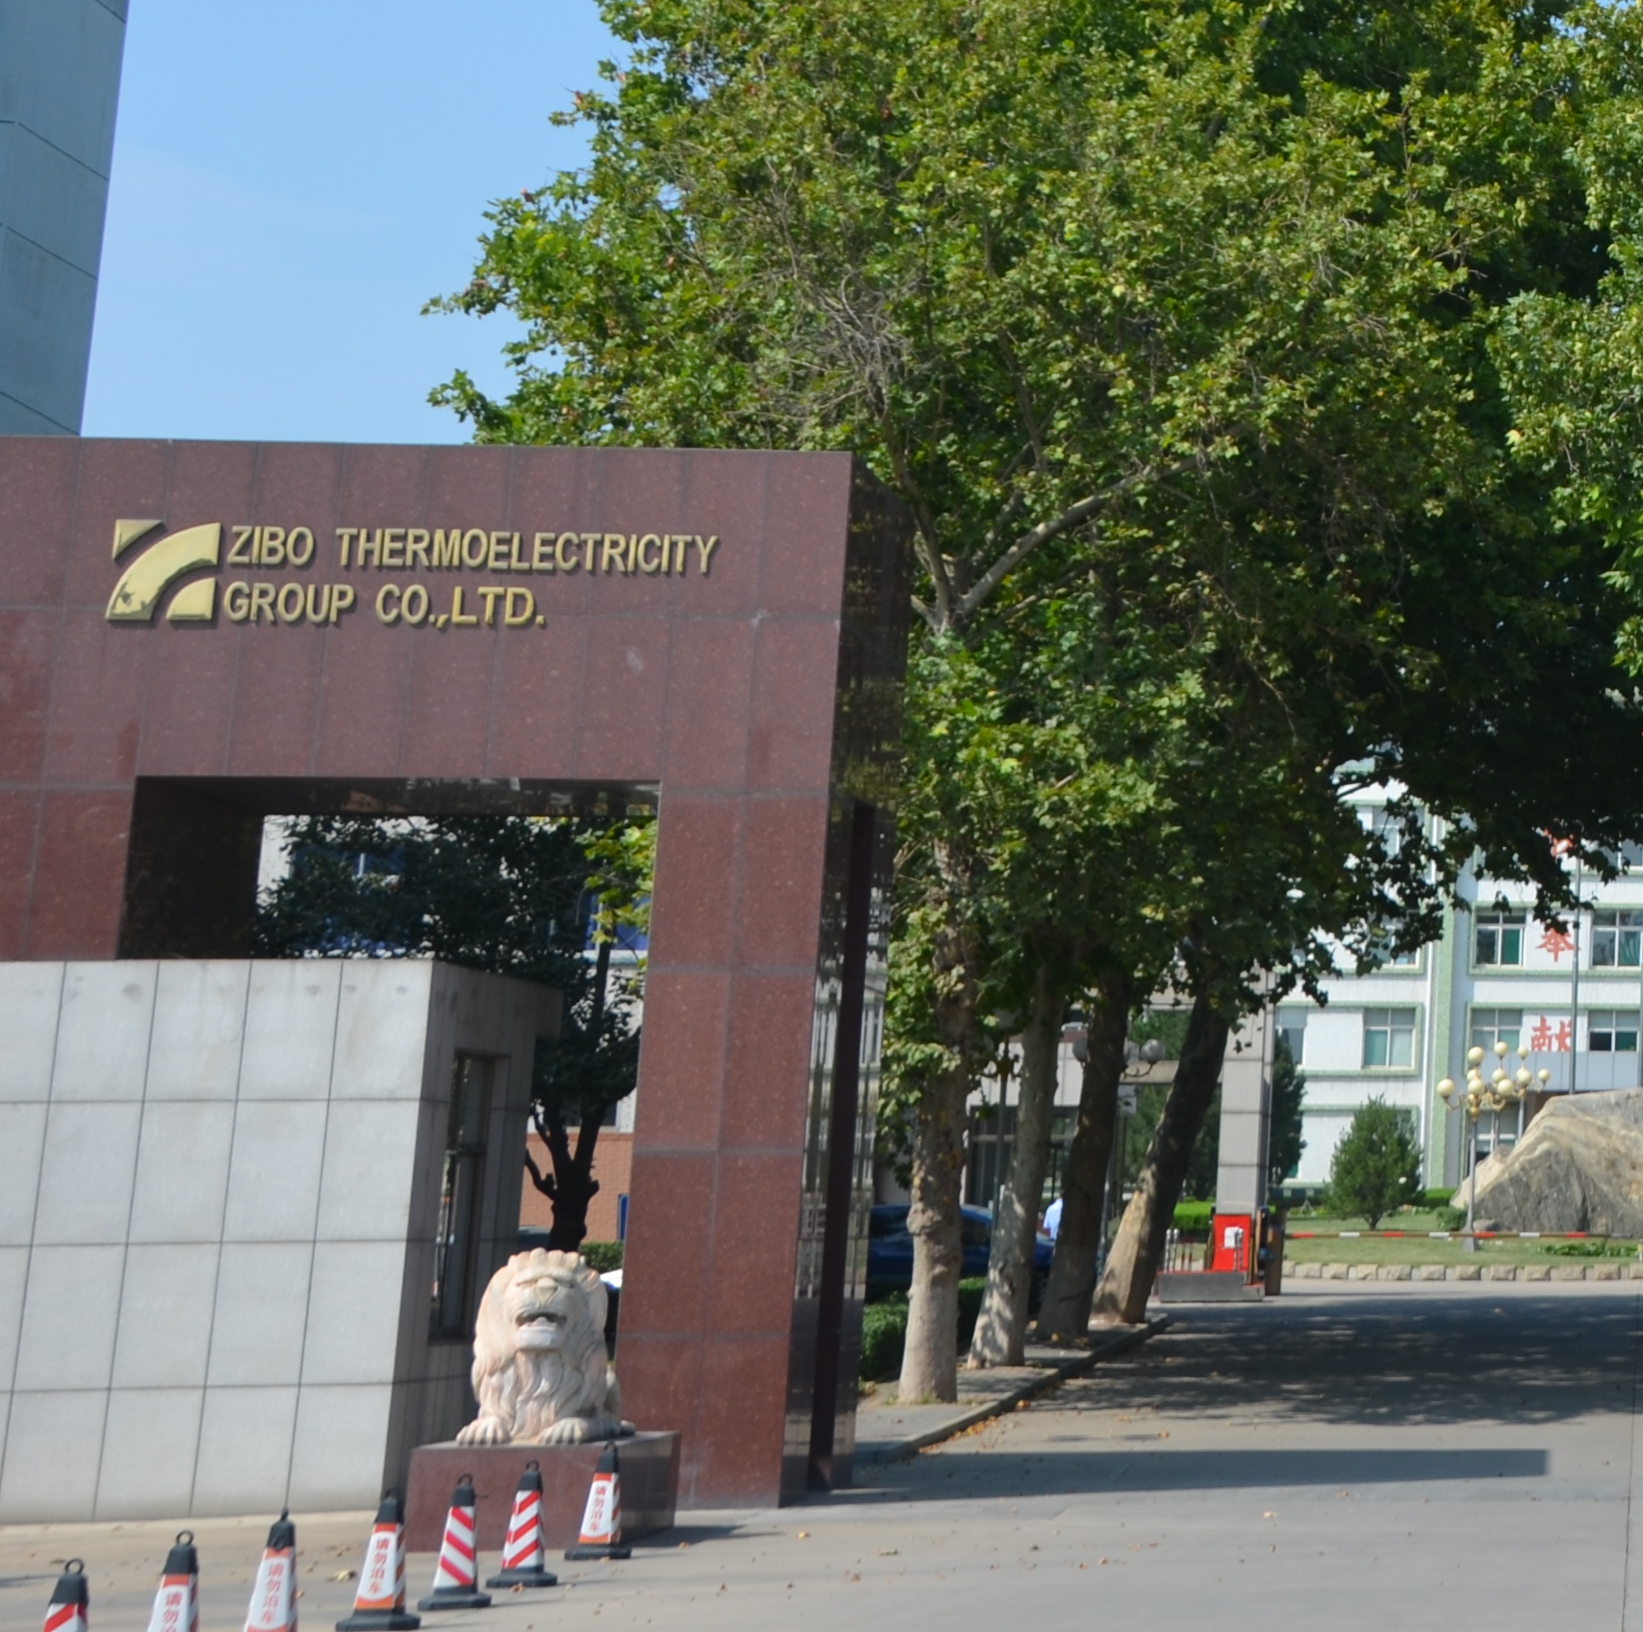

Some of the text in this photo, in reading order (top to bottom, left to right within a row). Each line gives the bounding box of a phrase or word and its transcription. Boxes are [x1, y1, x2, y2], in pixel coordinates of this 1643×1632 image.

[227, 524, 719, 574] ZIBO THERMOELECTRICITY
[223, 580, 355, 625] GROUP
